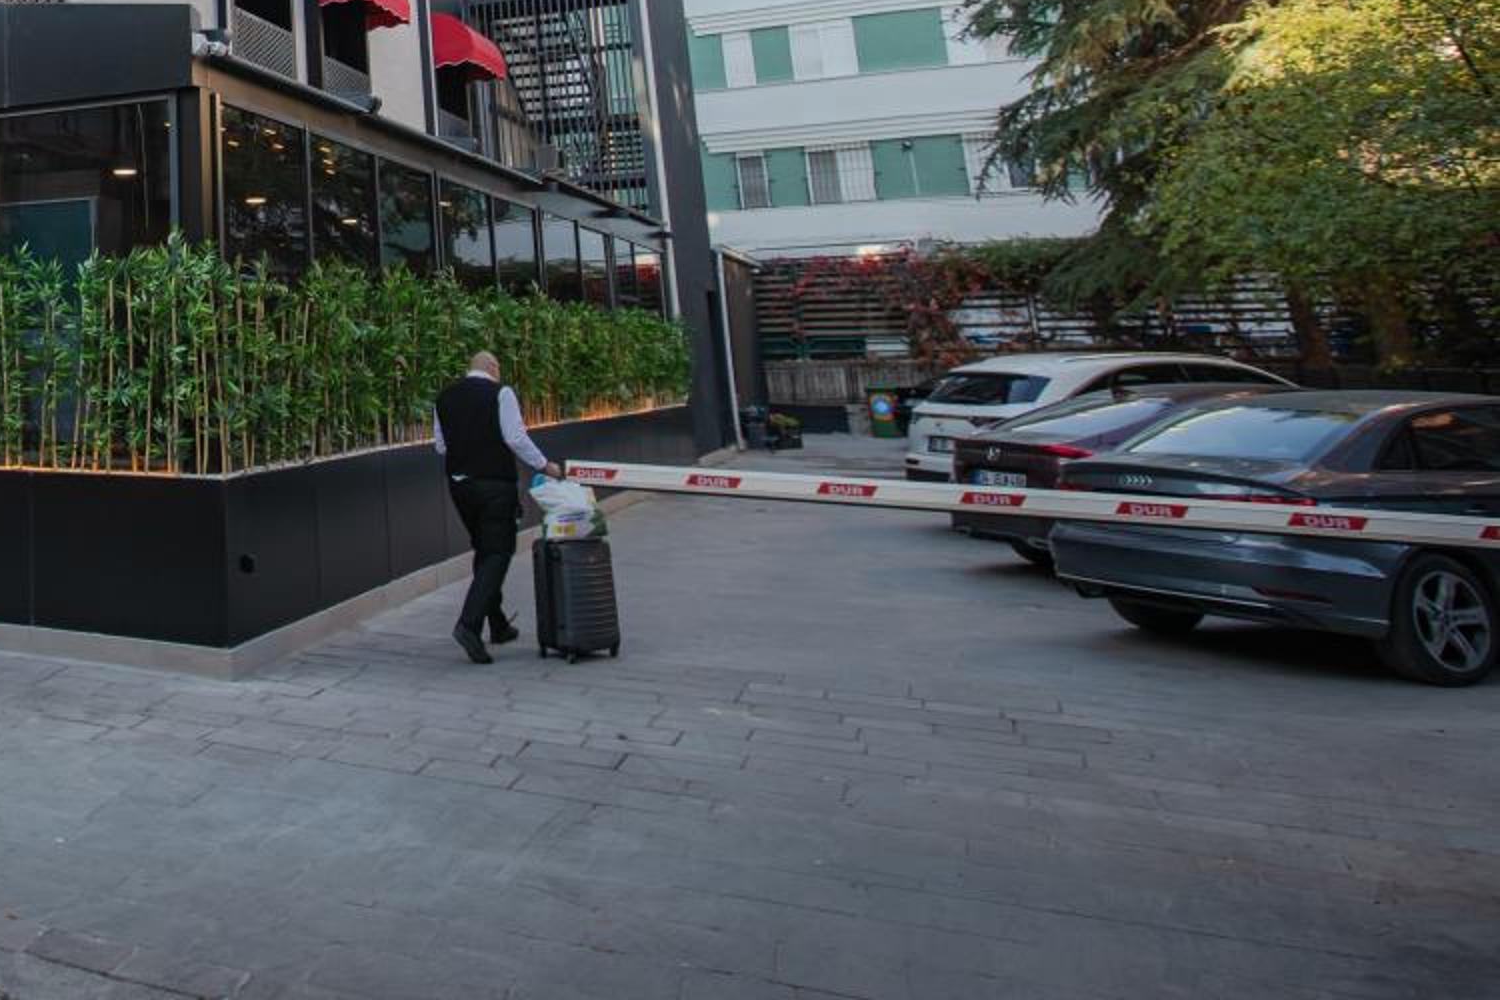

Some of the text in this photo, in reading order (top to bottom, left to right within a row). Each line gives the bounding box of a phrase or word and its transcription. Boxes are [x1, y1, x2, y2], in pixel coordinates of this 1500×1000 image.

[576, 468, 606, 480] DUR
[697, 476, 730, 488] DUR
[828, 485, 863, 497] DUR
[973, 494, 1011, 506] DUR
[1130, 504, 1172, 517] DUR
[1305, 516, 1350, 529] DUR
